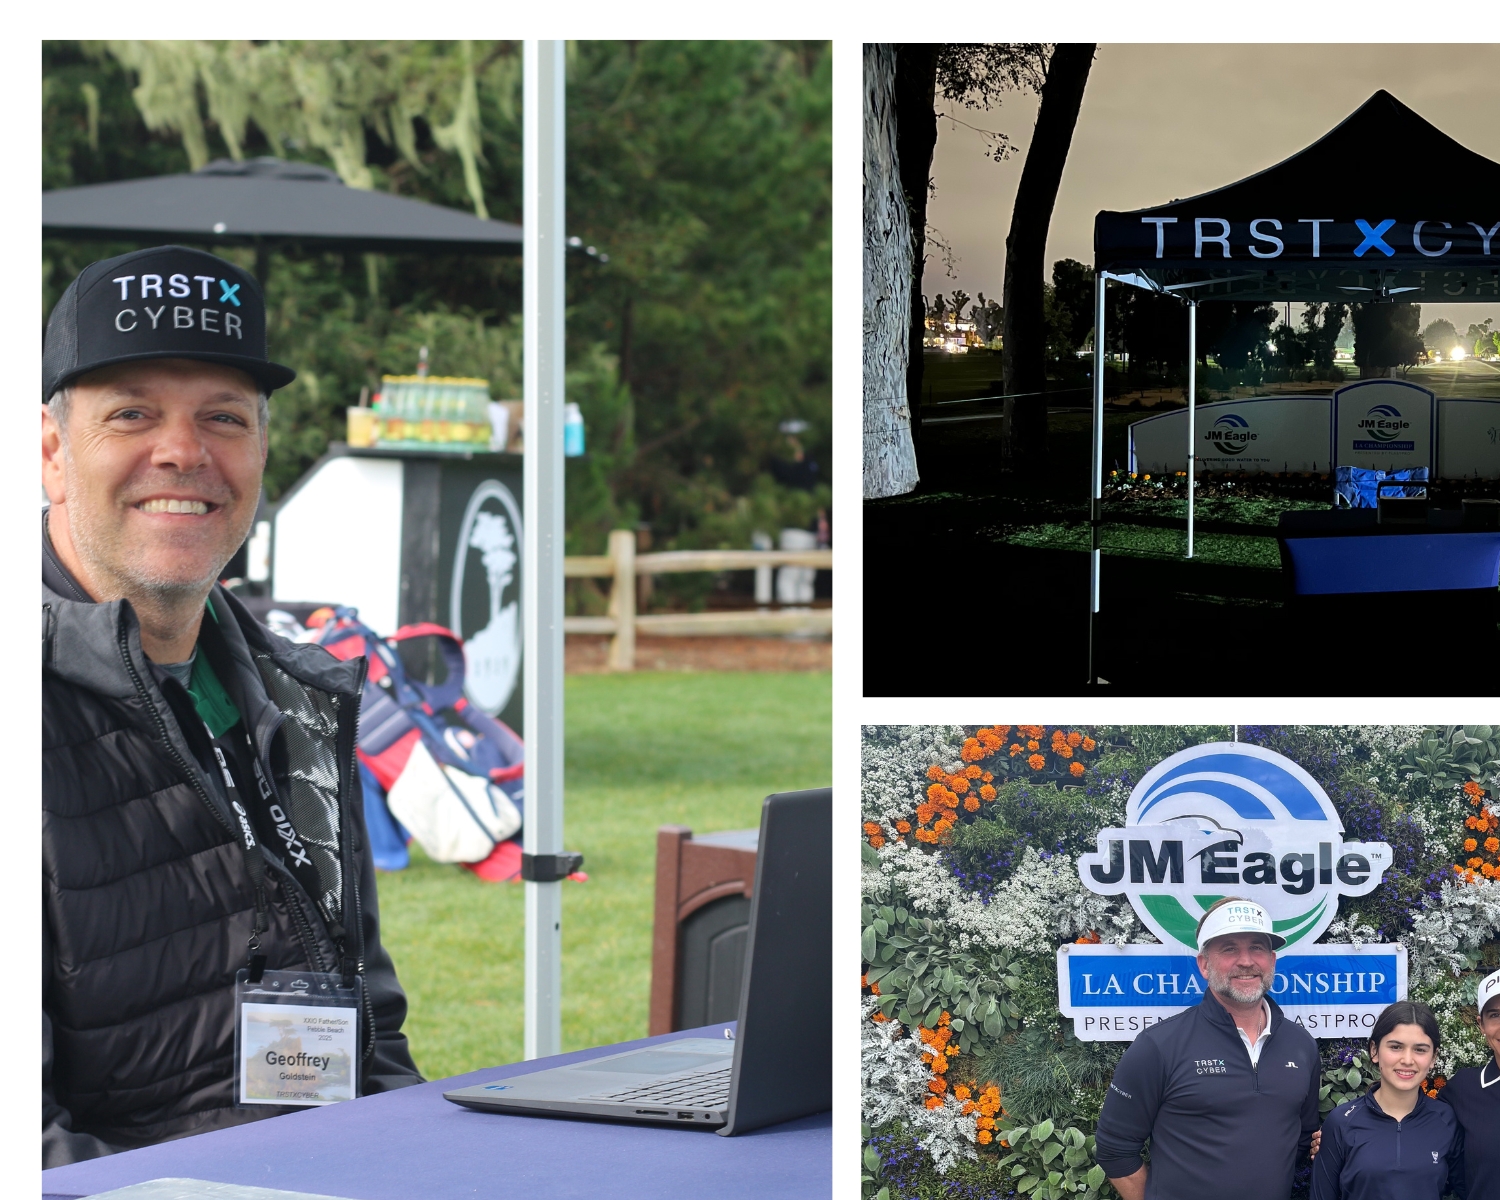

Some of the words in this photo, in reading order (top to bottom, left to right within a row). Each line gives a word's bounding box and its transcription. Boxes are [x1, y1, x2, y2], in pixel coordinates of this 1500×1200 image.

[114, 304, 243, 340] CYBER
[1358, 419, 1375, 430] JM
[1377, 419, 1410, 431] Eagle
[1204, 430, 1223, 441] JM
[1224, 430, 1258, 443] Eagle
[1089, 839, 1185, 885] JM
[1199, 838, 1371, 896] Eagle
[1228, 914, 1264, 926] CYBER
[1081, 973, 1118, 996] LA
[1132, 971, 1386, 996] CHAONSHIP
[1294, 1012, 1376, 1028] ASTPRO
[266, 1050, 330, 1071] Geoffrey
[280, 1072, 316, 1081] Goldstein
[1196, 1066, 1227, 1074] CYBER
